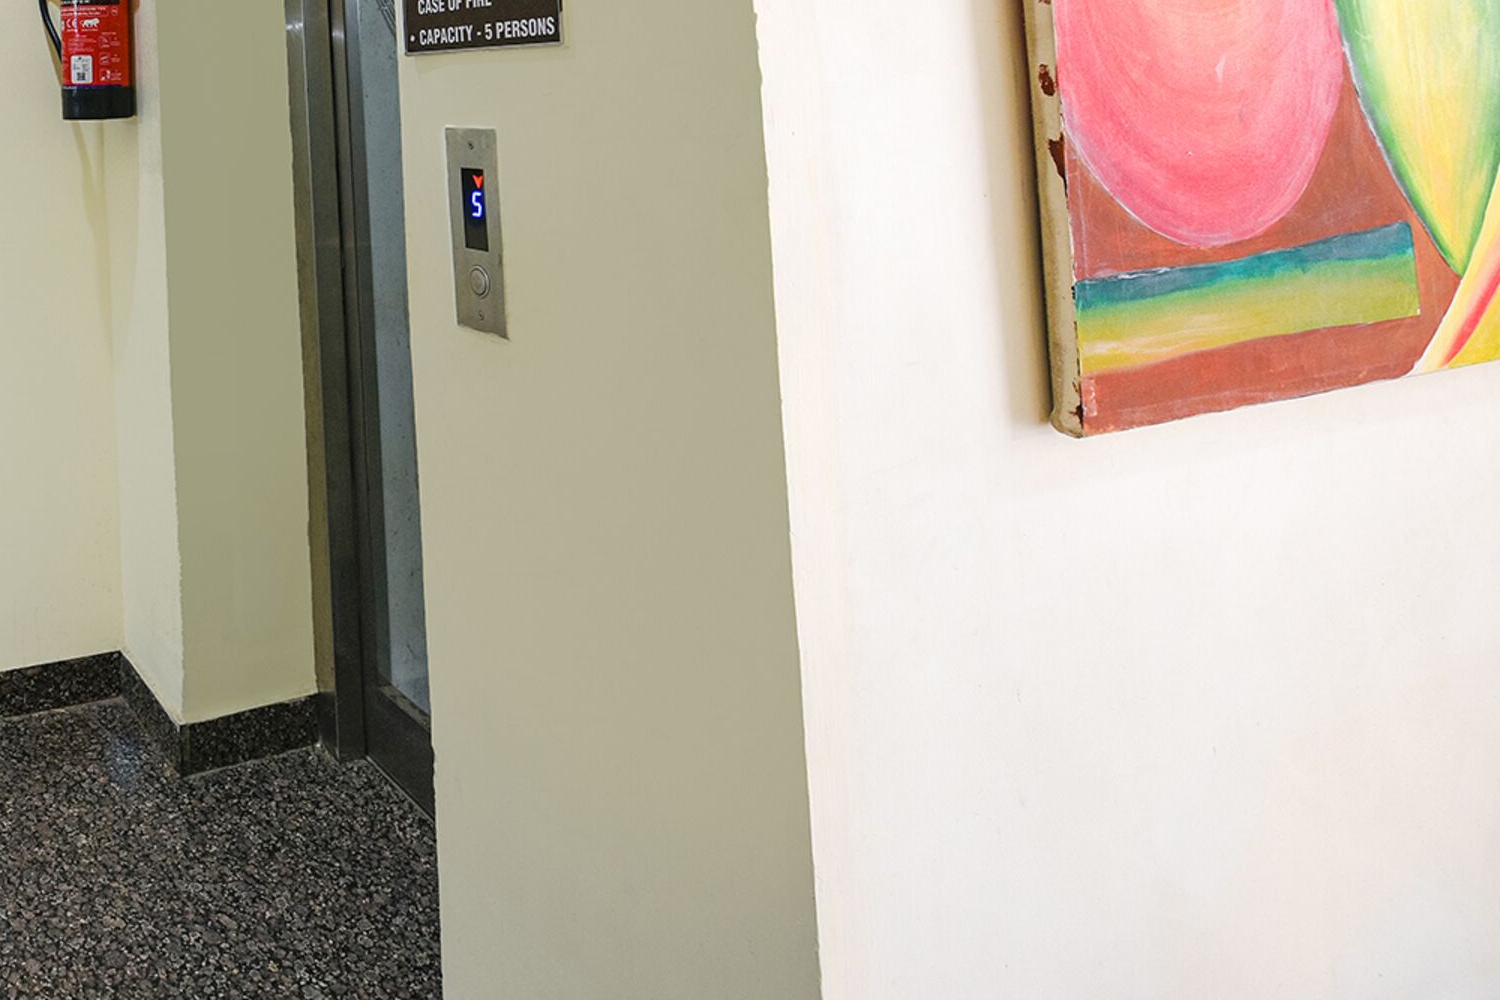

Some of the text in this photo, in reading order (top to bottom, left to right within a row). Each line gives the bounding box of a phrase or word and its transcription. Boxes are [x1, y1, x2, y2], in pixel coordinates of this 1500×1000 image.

[419, 25, 473, 45] CAPACITY
[485, 24, 493, 40] 5
[496, 17, 555, 38] PERSONS
[471, 192, 482, 217] 5
